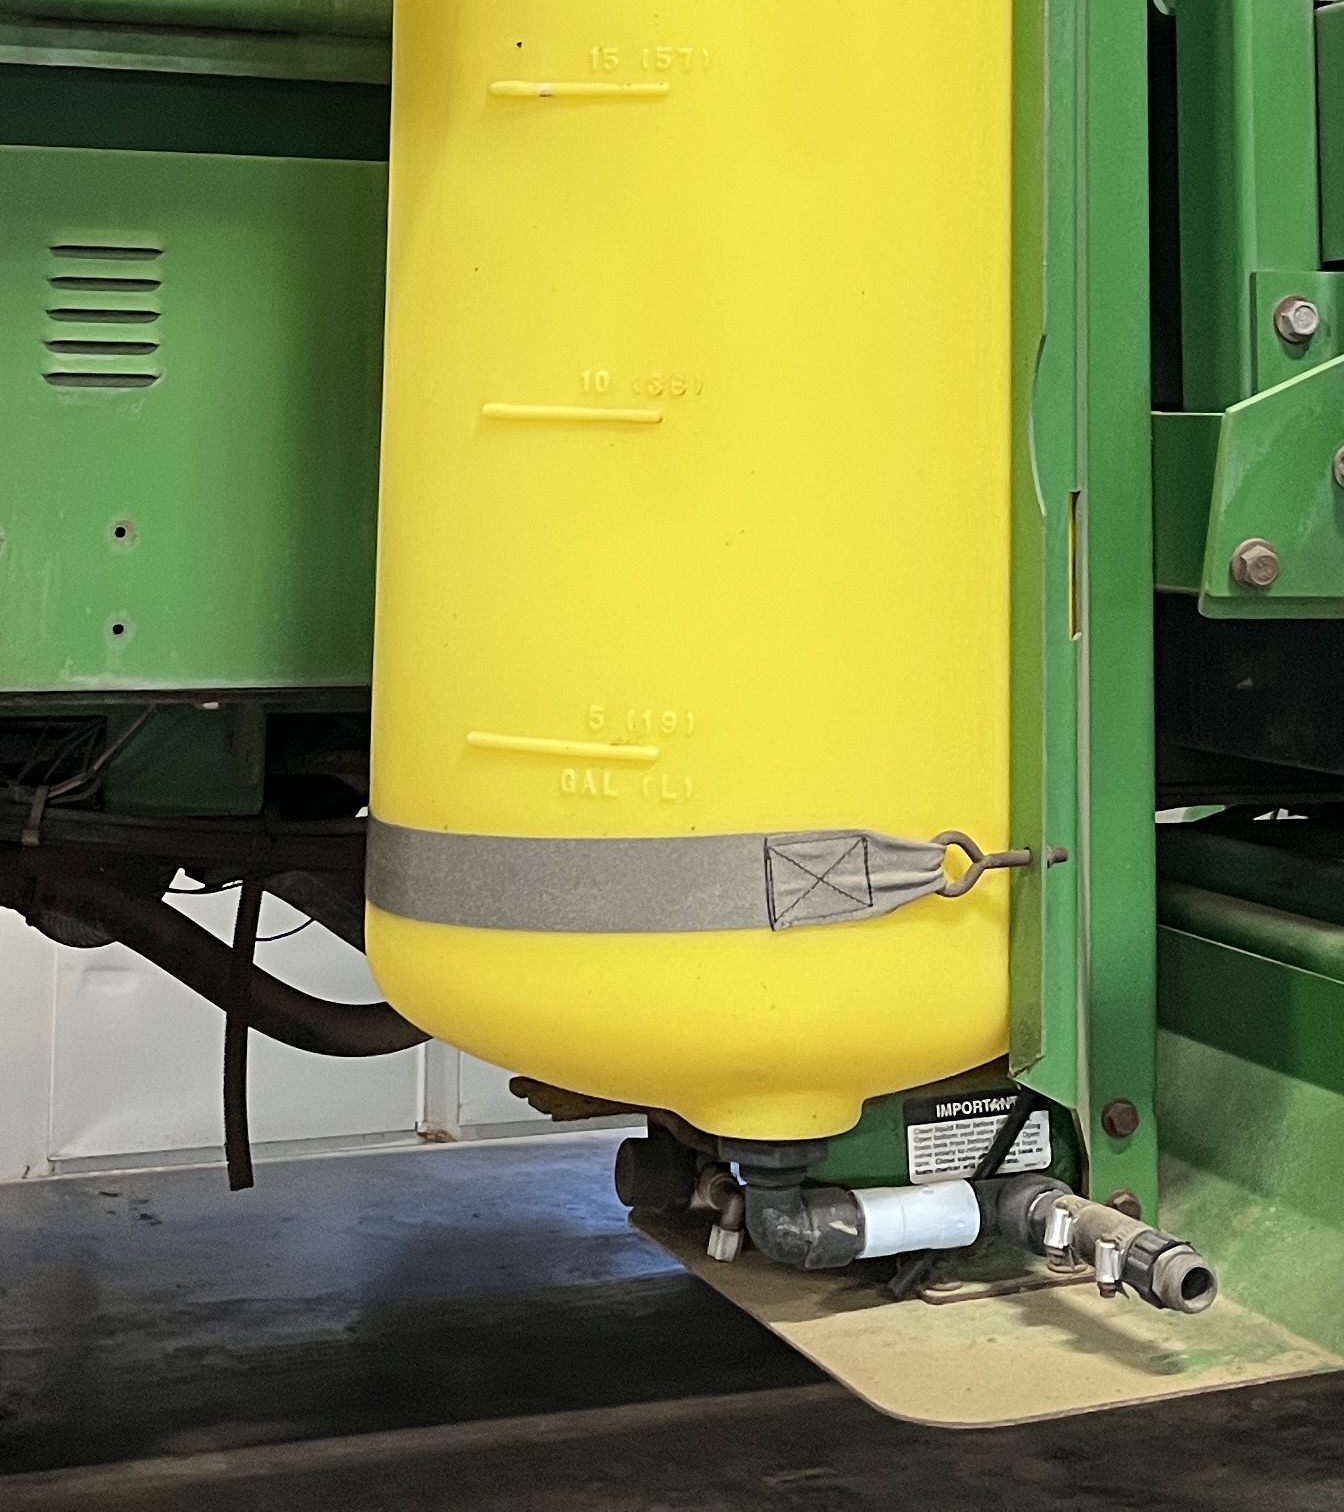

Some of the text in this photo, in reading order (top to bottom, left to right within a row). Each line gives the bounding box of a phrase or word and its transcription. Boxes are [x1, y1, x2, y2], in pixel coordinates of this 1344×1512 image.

[590, 46, 711, 72] 15 (57)
[581, 369, 610, 393] 10
[588, 704, 695, 735] 5 (19)
[560, 768, 693, 799] GAL (L)
[936, 1095, 1019, 1118] IMPORTANT
